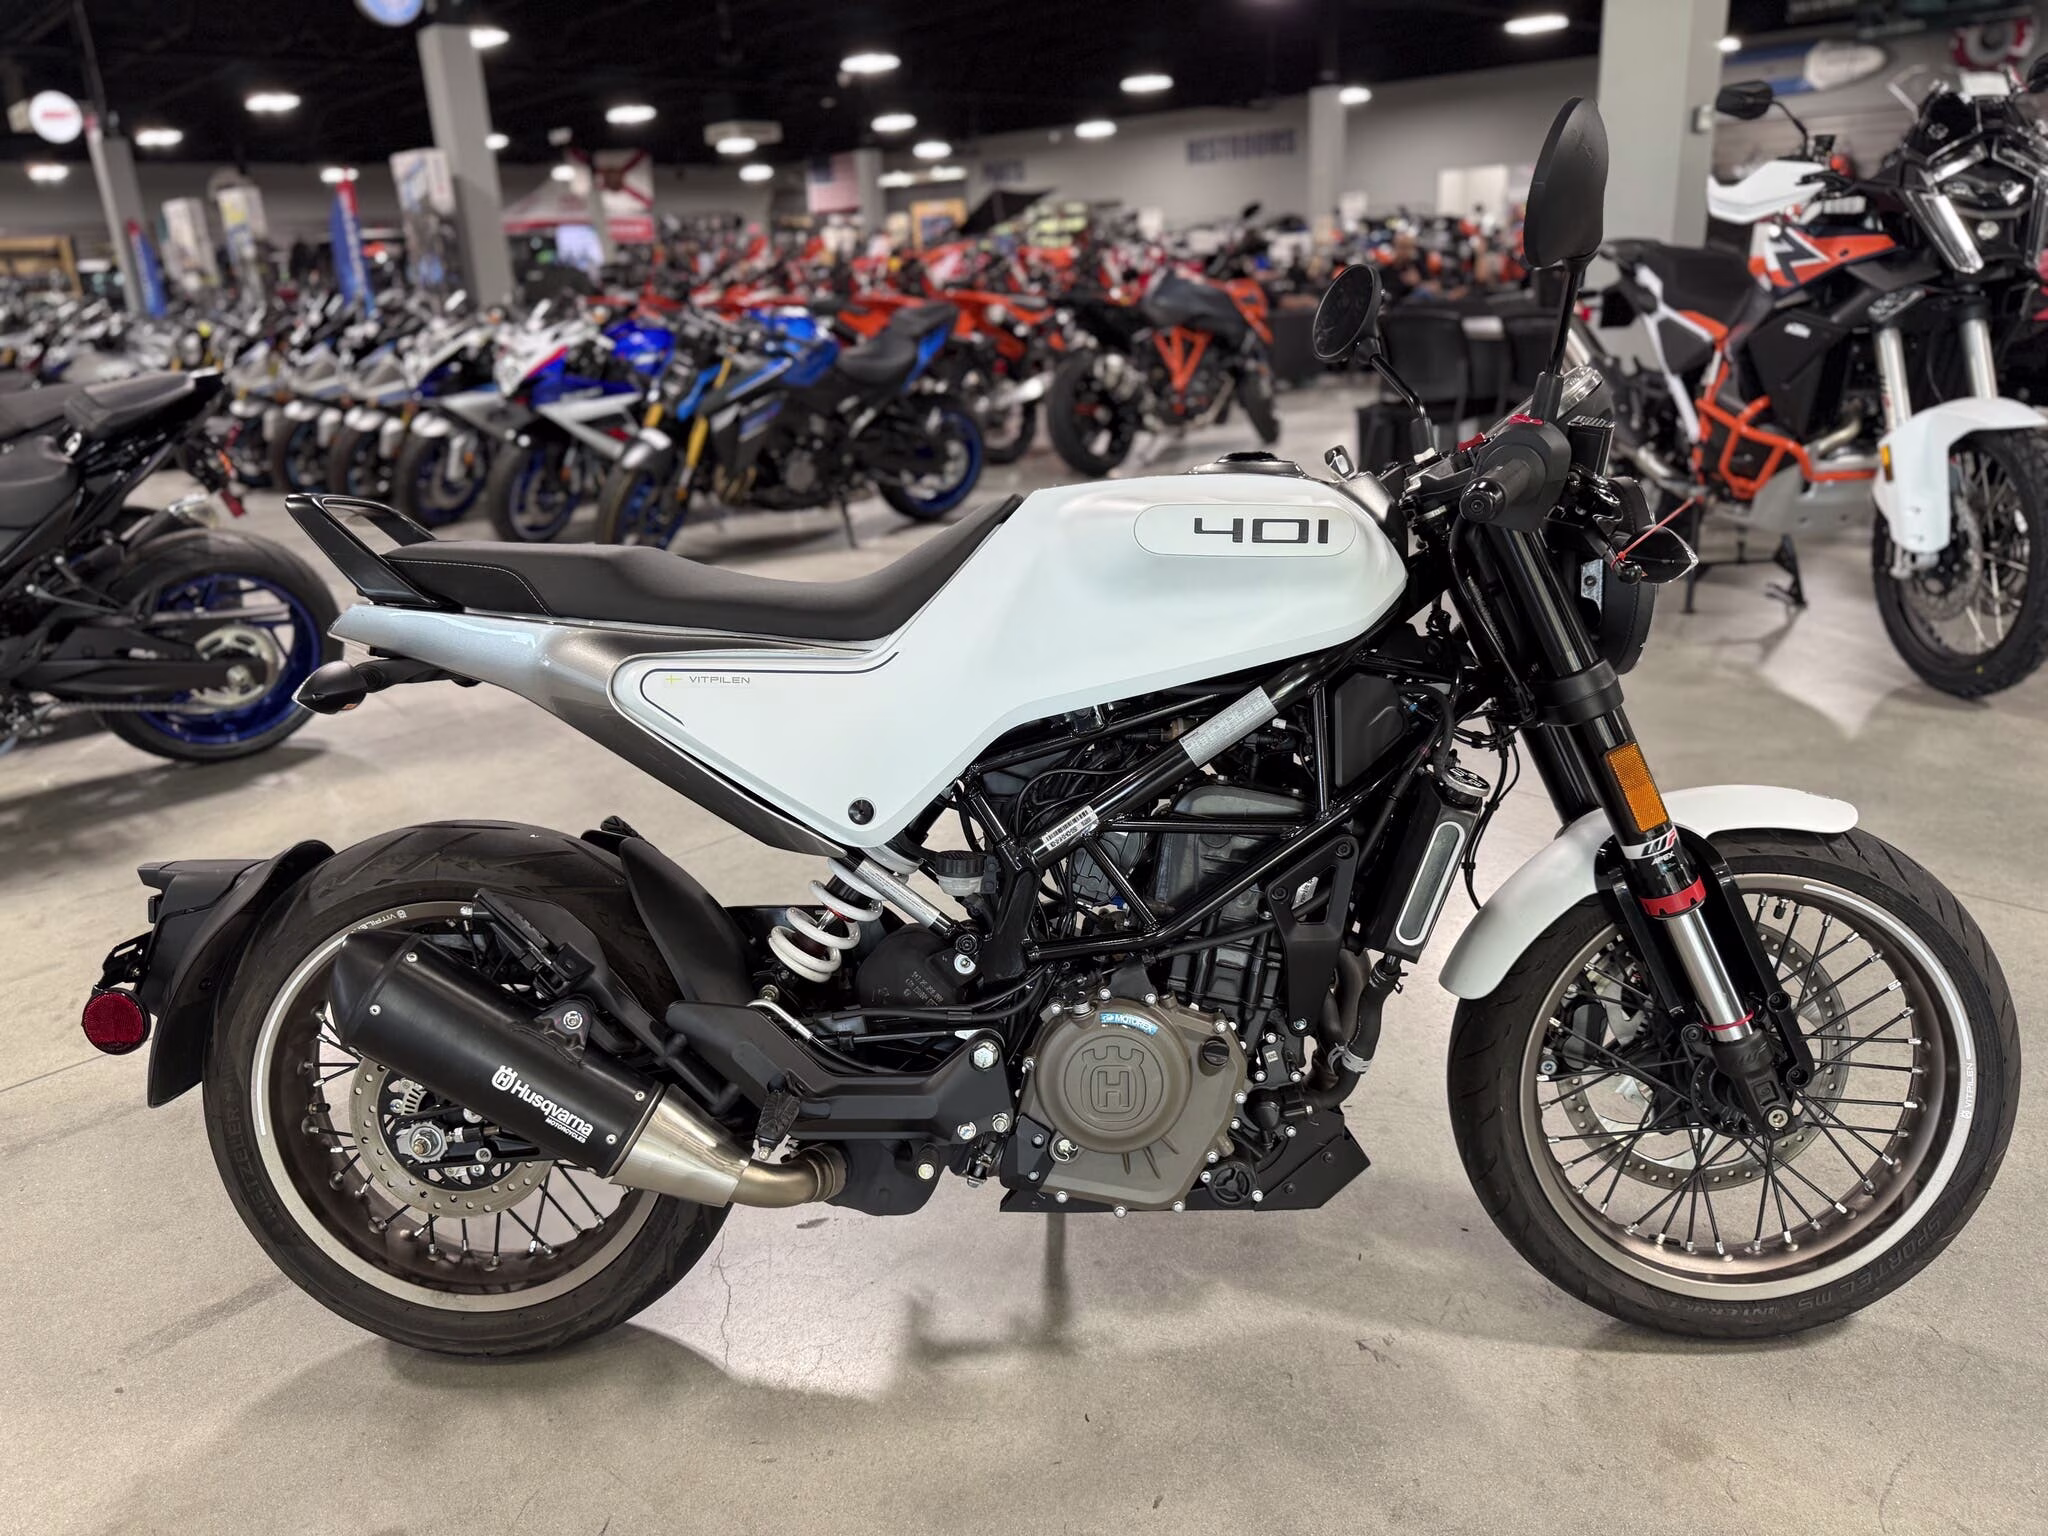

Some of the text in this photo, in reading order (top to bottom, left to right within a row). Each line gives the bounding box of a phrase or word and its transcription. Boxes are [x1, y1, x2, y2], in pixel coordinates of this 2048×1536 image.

[1194, 517, 1329, 544] 401
[689, 676, 751, 684] VITPILEN
[351, 913, 397, 933] VITPILE
[1115, 1014, 1154, 1034] MOTOREX
[1966, 1062, 1975, 1109] VITPILEN
[510, 1079, 593, 1137] Husqvarna
[545, 1117, 586, 1144] MOTORCYCLES
[1840, 1217, 1942, 1295] SPORTEC
